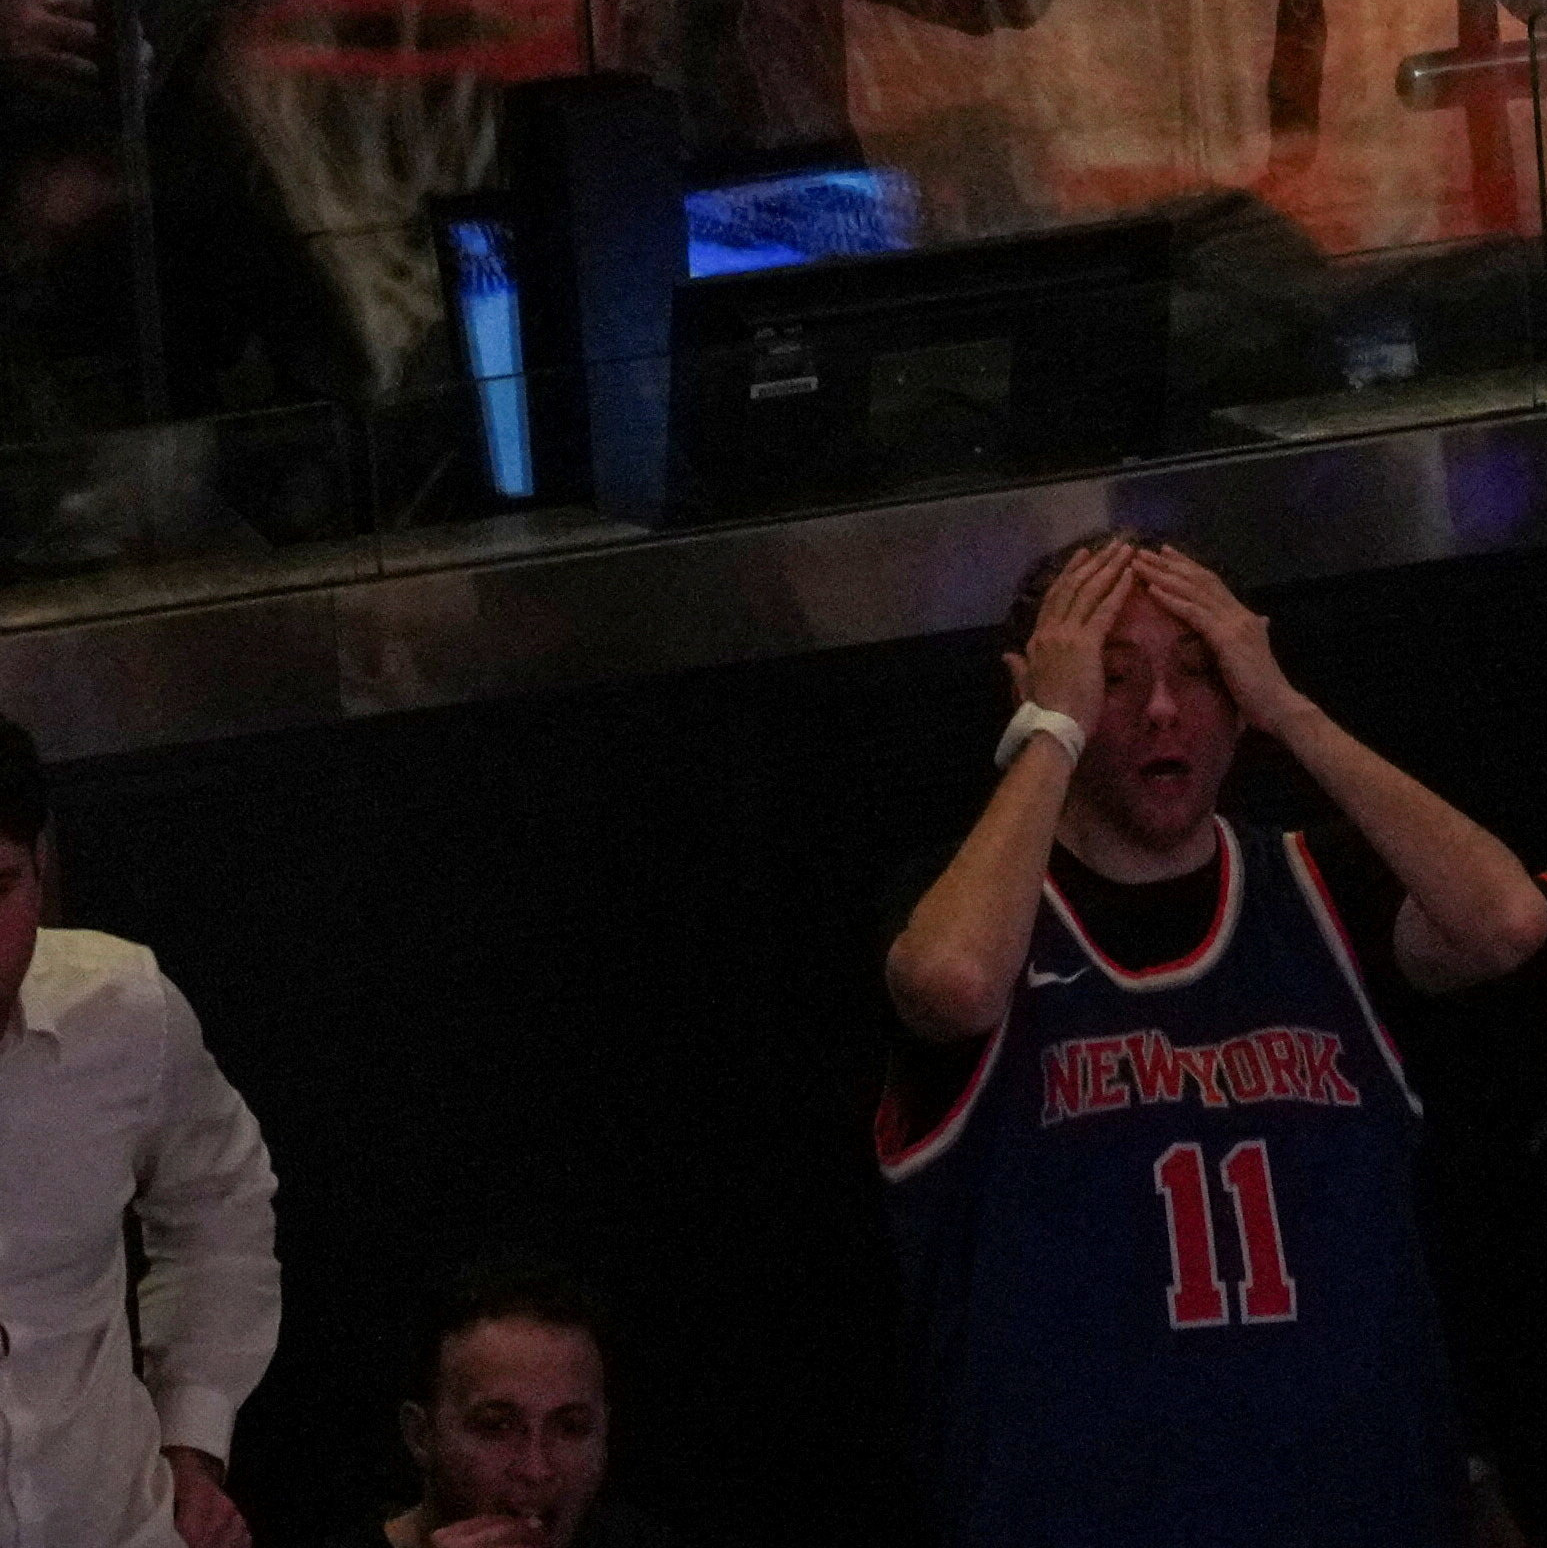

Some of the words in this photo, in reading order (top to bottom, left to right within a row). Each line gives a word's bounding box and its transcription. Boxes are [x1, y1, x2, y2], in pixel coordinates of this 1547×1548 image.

[1040, 1027, 1184, 1129] NEW
[1173, 1025, 1363, 1109] YORK
[1153, 1138, 1298, 1331] 11
